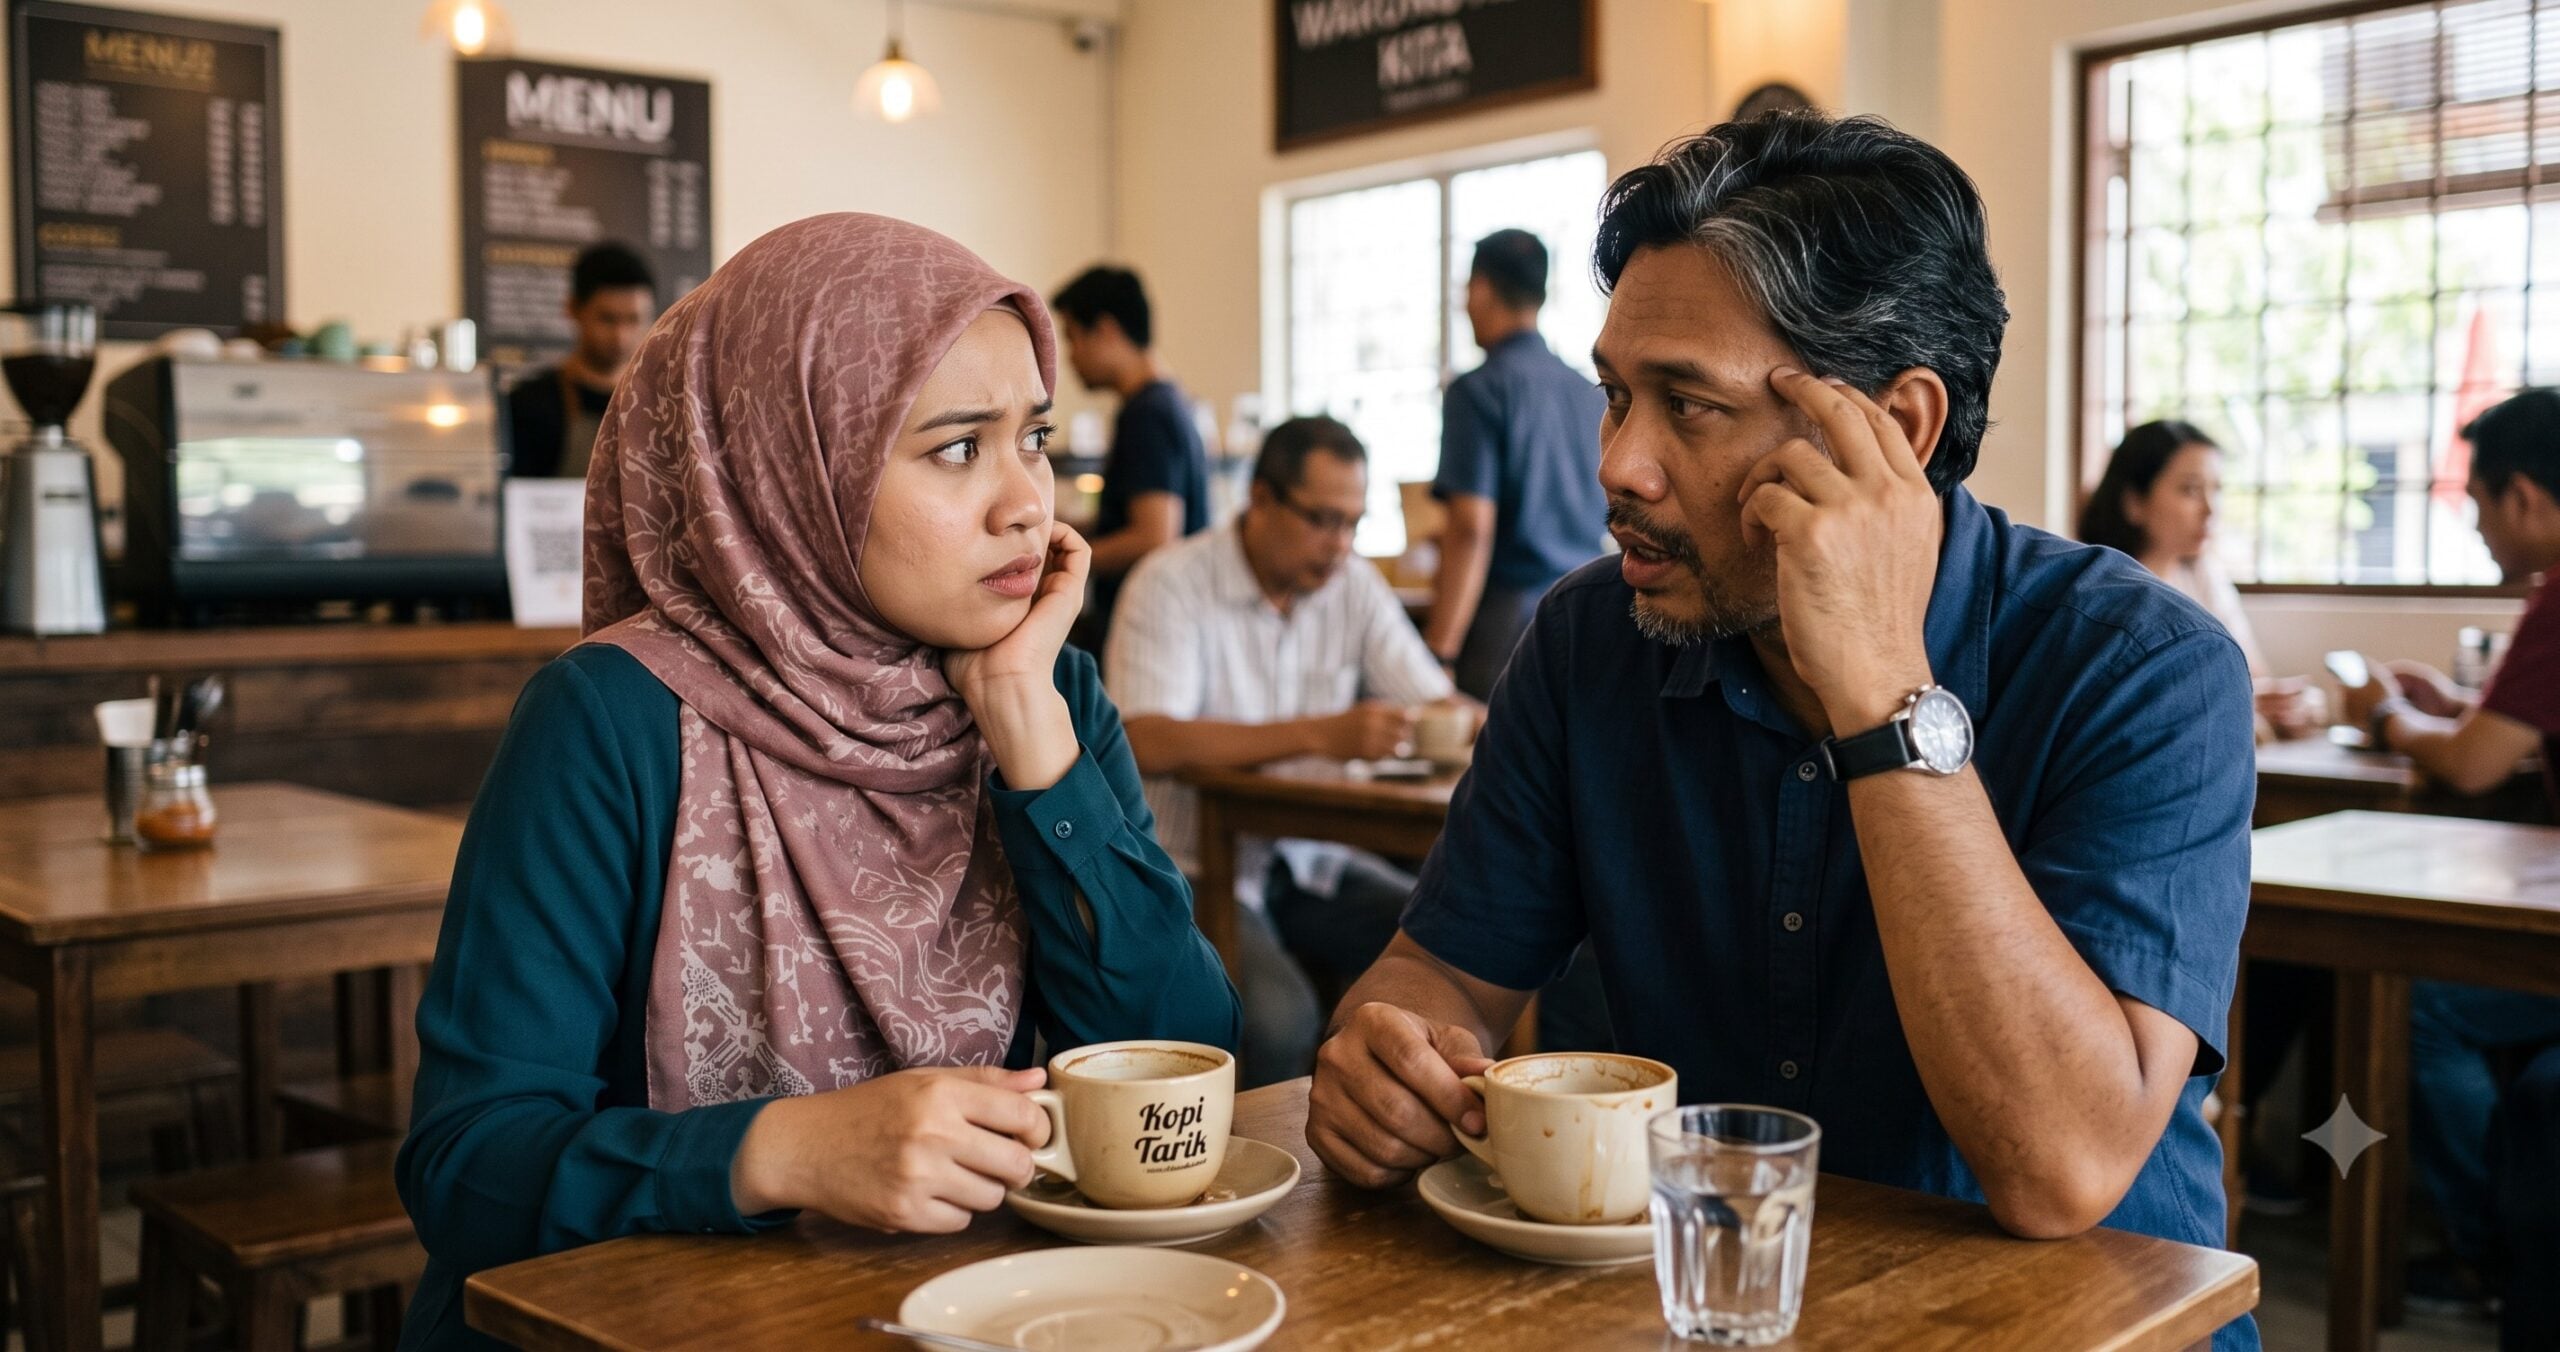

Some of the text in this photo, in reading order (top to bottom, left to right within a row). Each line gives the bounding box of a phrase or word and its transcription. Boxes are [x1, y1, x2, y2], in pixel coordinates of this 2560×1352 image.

[506, 70, 673, 143] MENU
[1139, 1096, 1205, 1136] Kopi
[1134, 1130, 1208, 1164] Tarik
